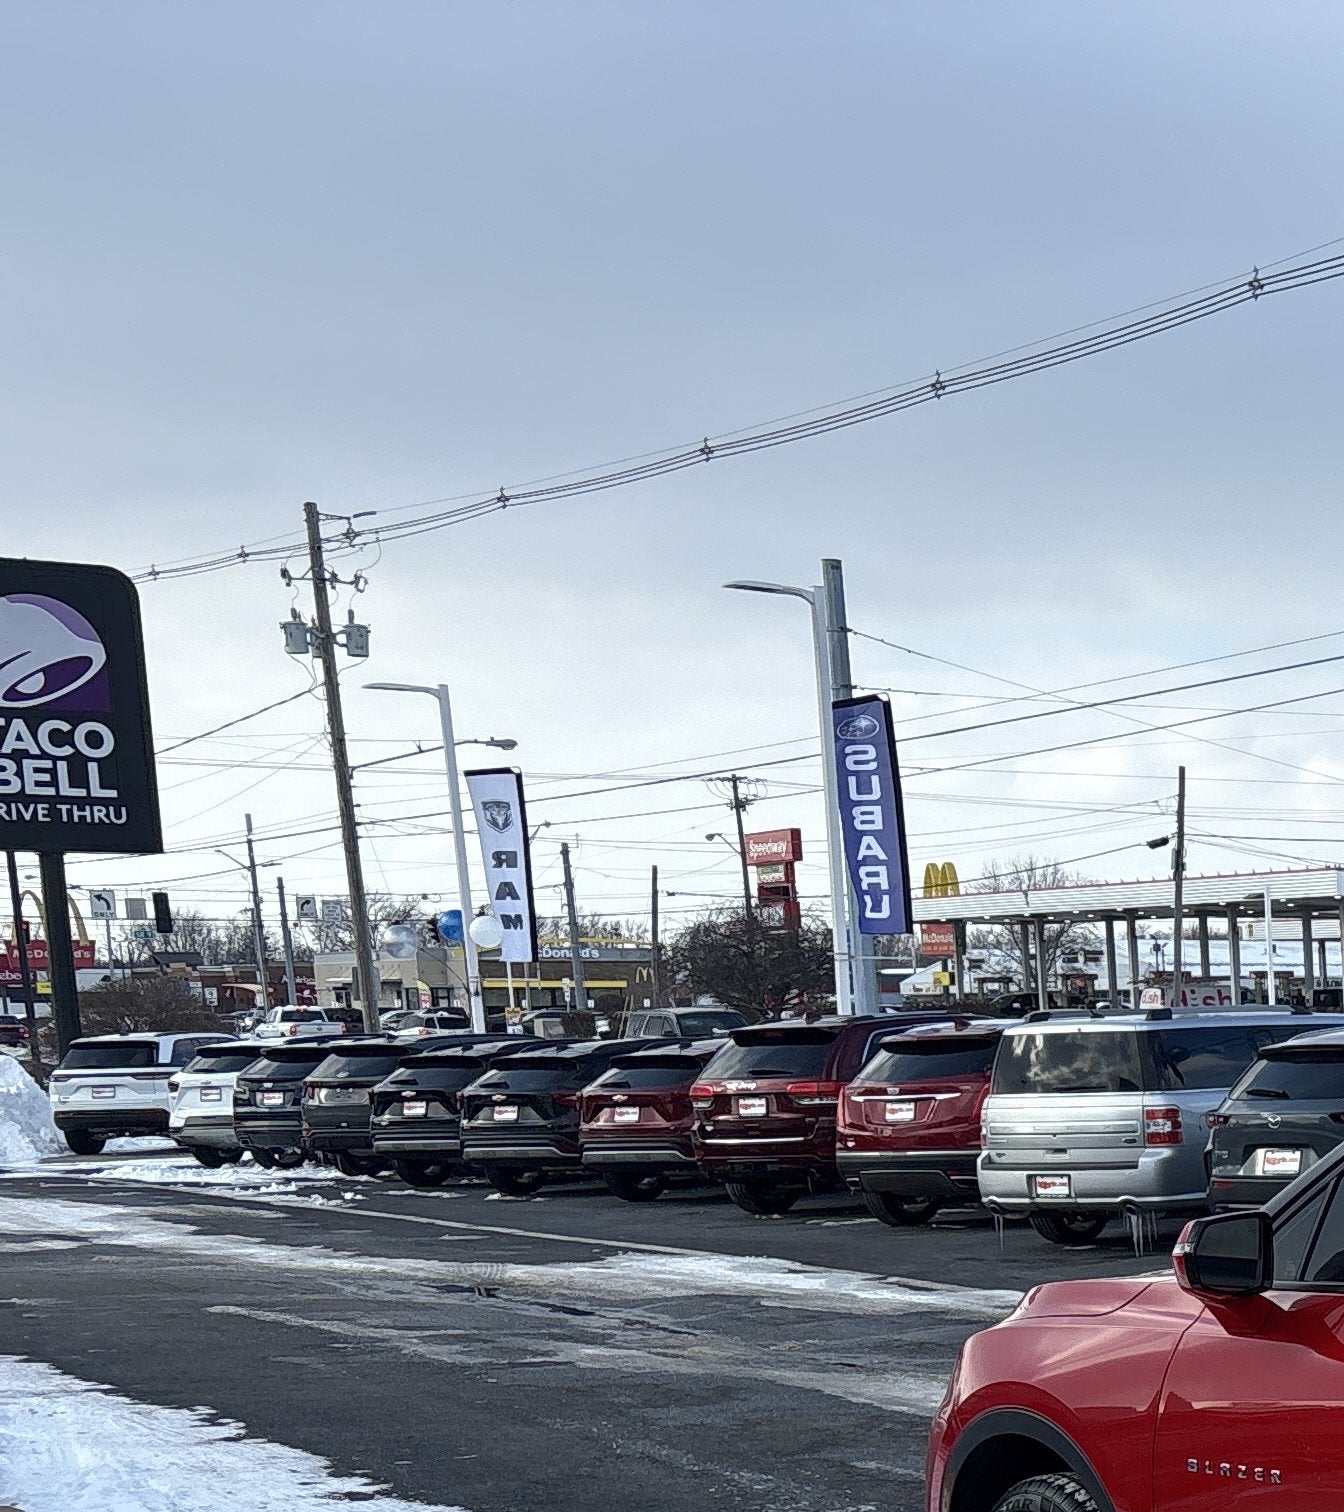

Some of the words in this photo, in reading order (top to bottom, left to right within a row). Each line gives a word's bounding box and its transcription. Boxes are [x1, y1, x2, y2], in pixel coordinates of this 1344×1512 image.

[0, 758, 118, 798] BELL
[0, 802, 52, 822] RIVE
[55, 804, 128, 825] THRU
[1142, 990, 1159, 1004] dish
[1186, 1458, 1282, 1484] BLAZER
